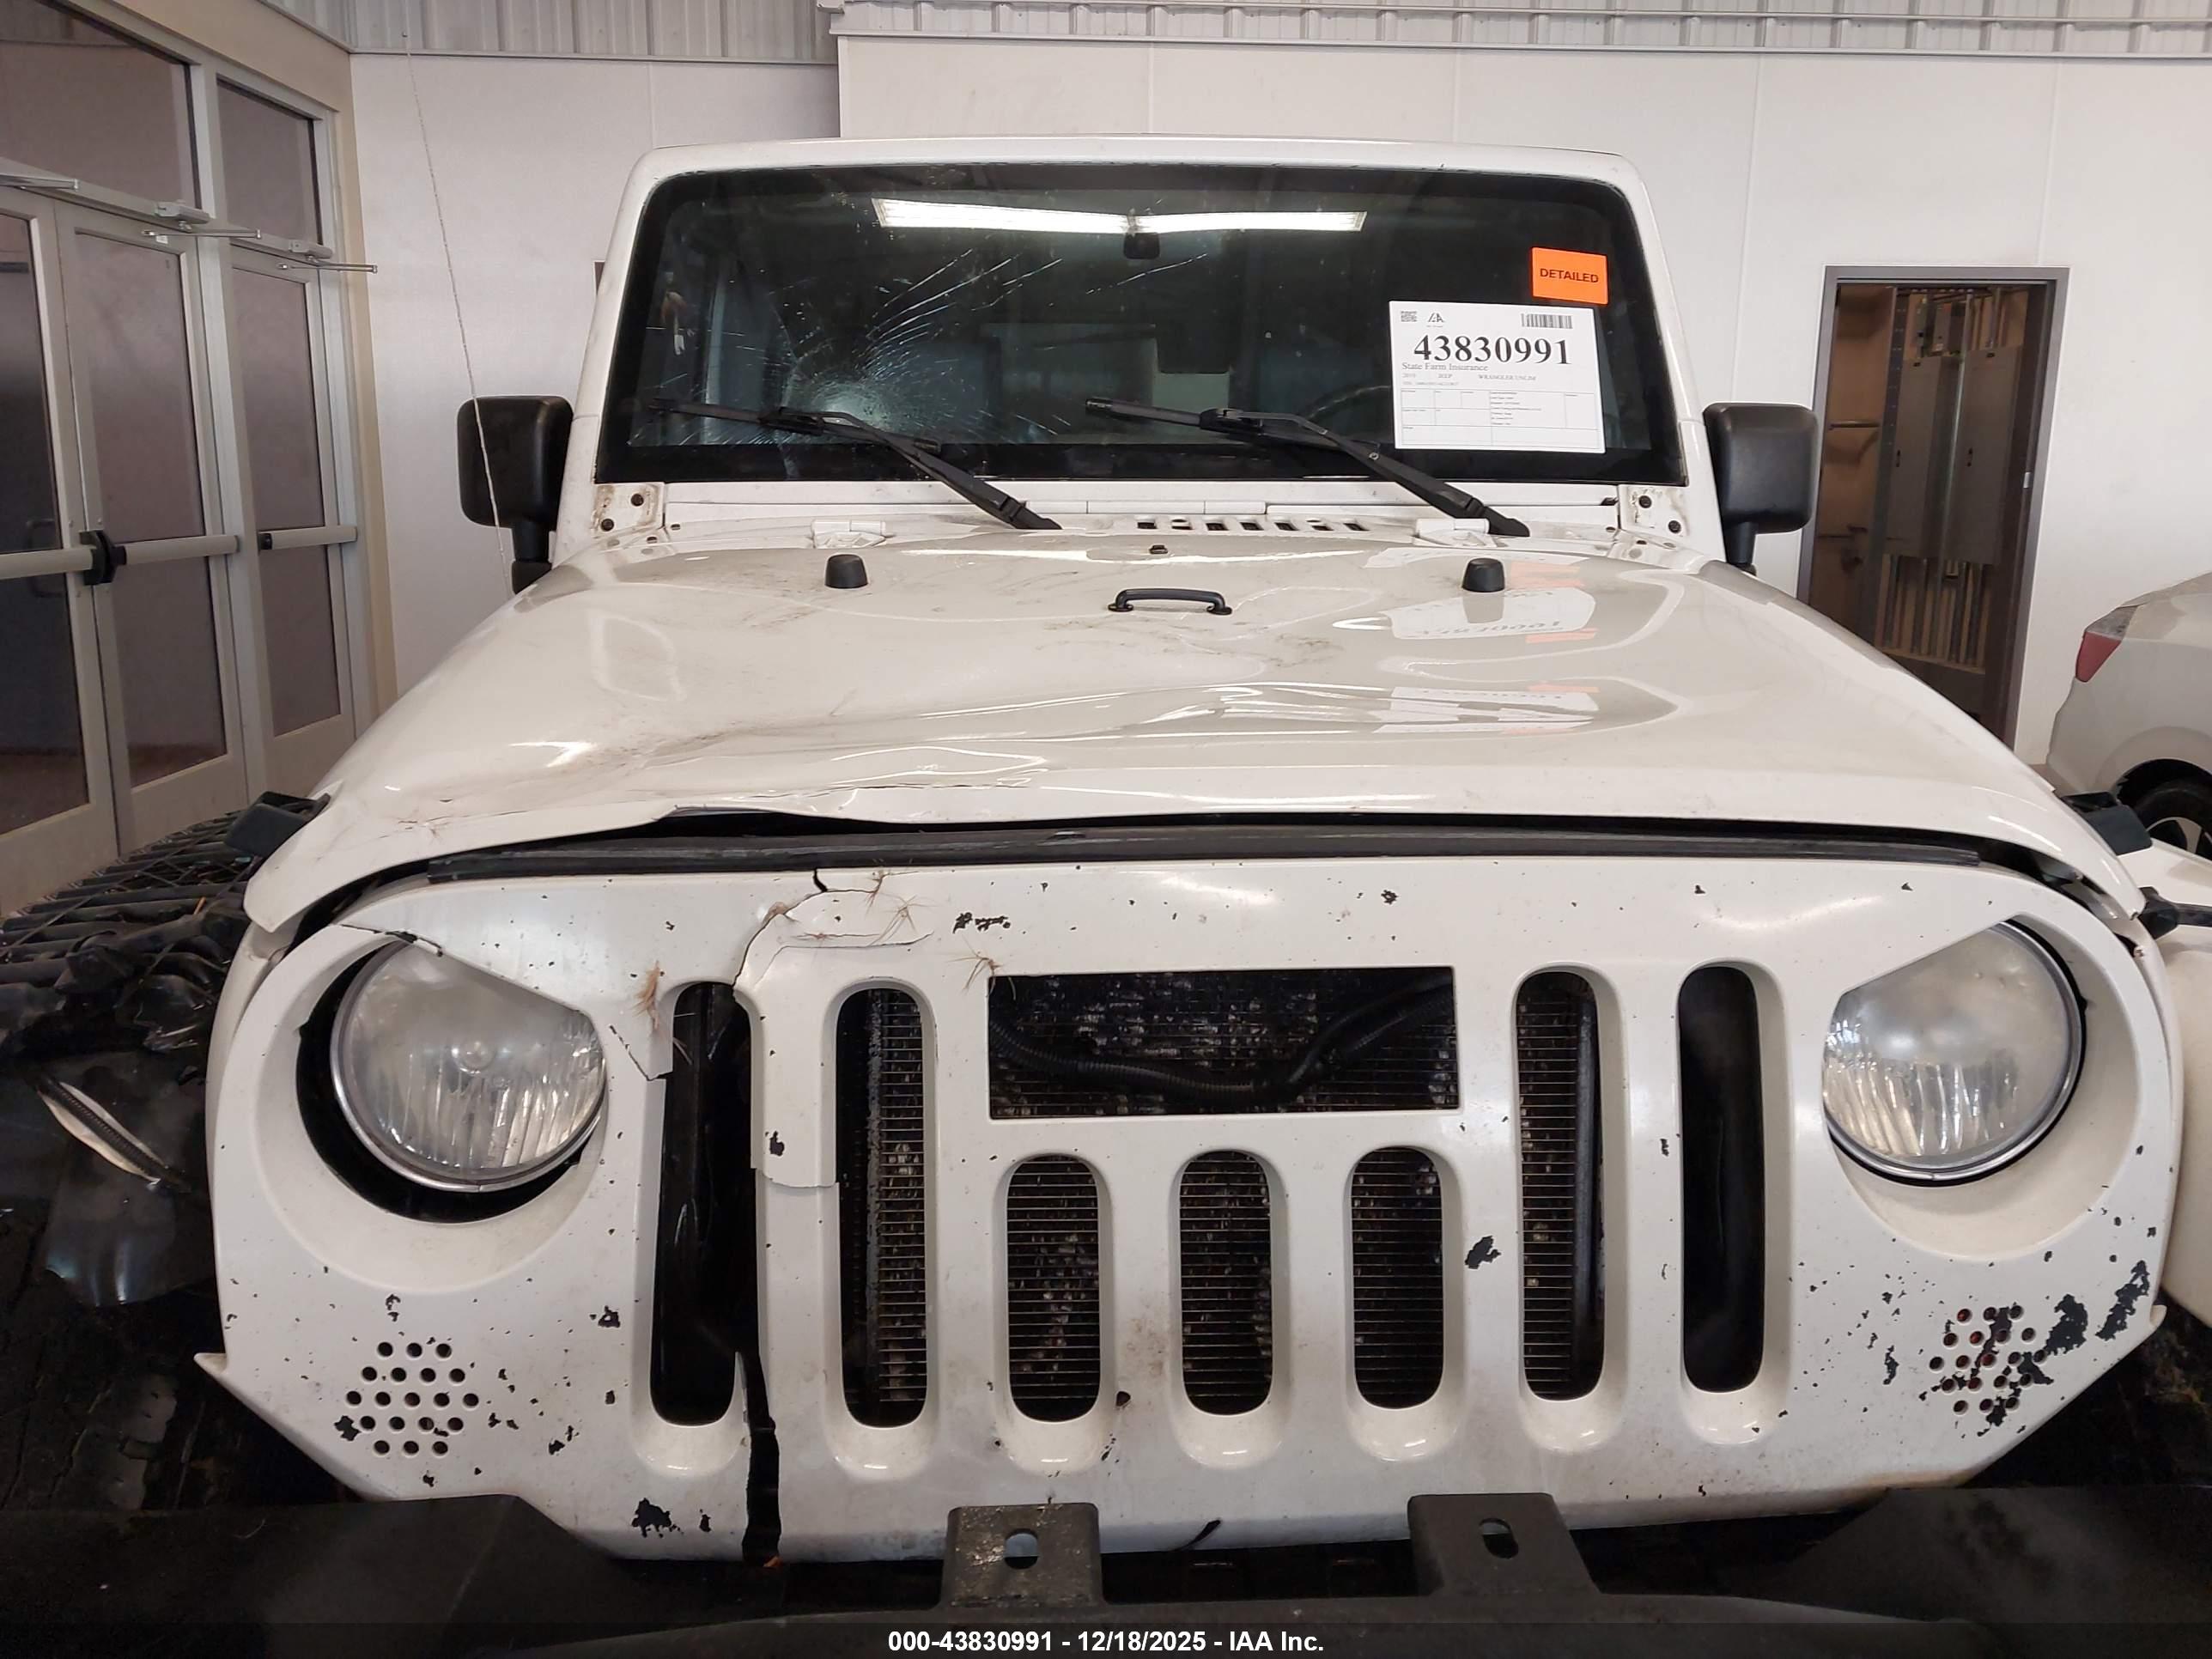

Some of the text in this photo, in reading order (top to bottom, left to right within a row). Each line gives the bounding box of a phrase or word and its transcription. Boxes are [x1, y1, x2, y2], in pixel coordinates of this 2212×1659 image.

[1539, 268, 1599, 284] DETAILED
[1413, 334, 1572, 365] 43830991
[1401, 362, 1423, 370] State
[1449, 362, 1490, 372] Insurance
